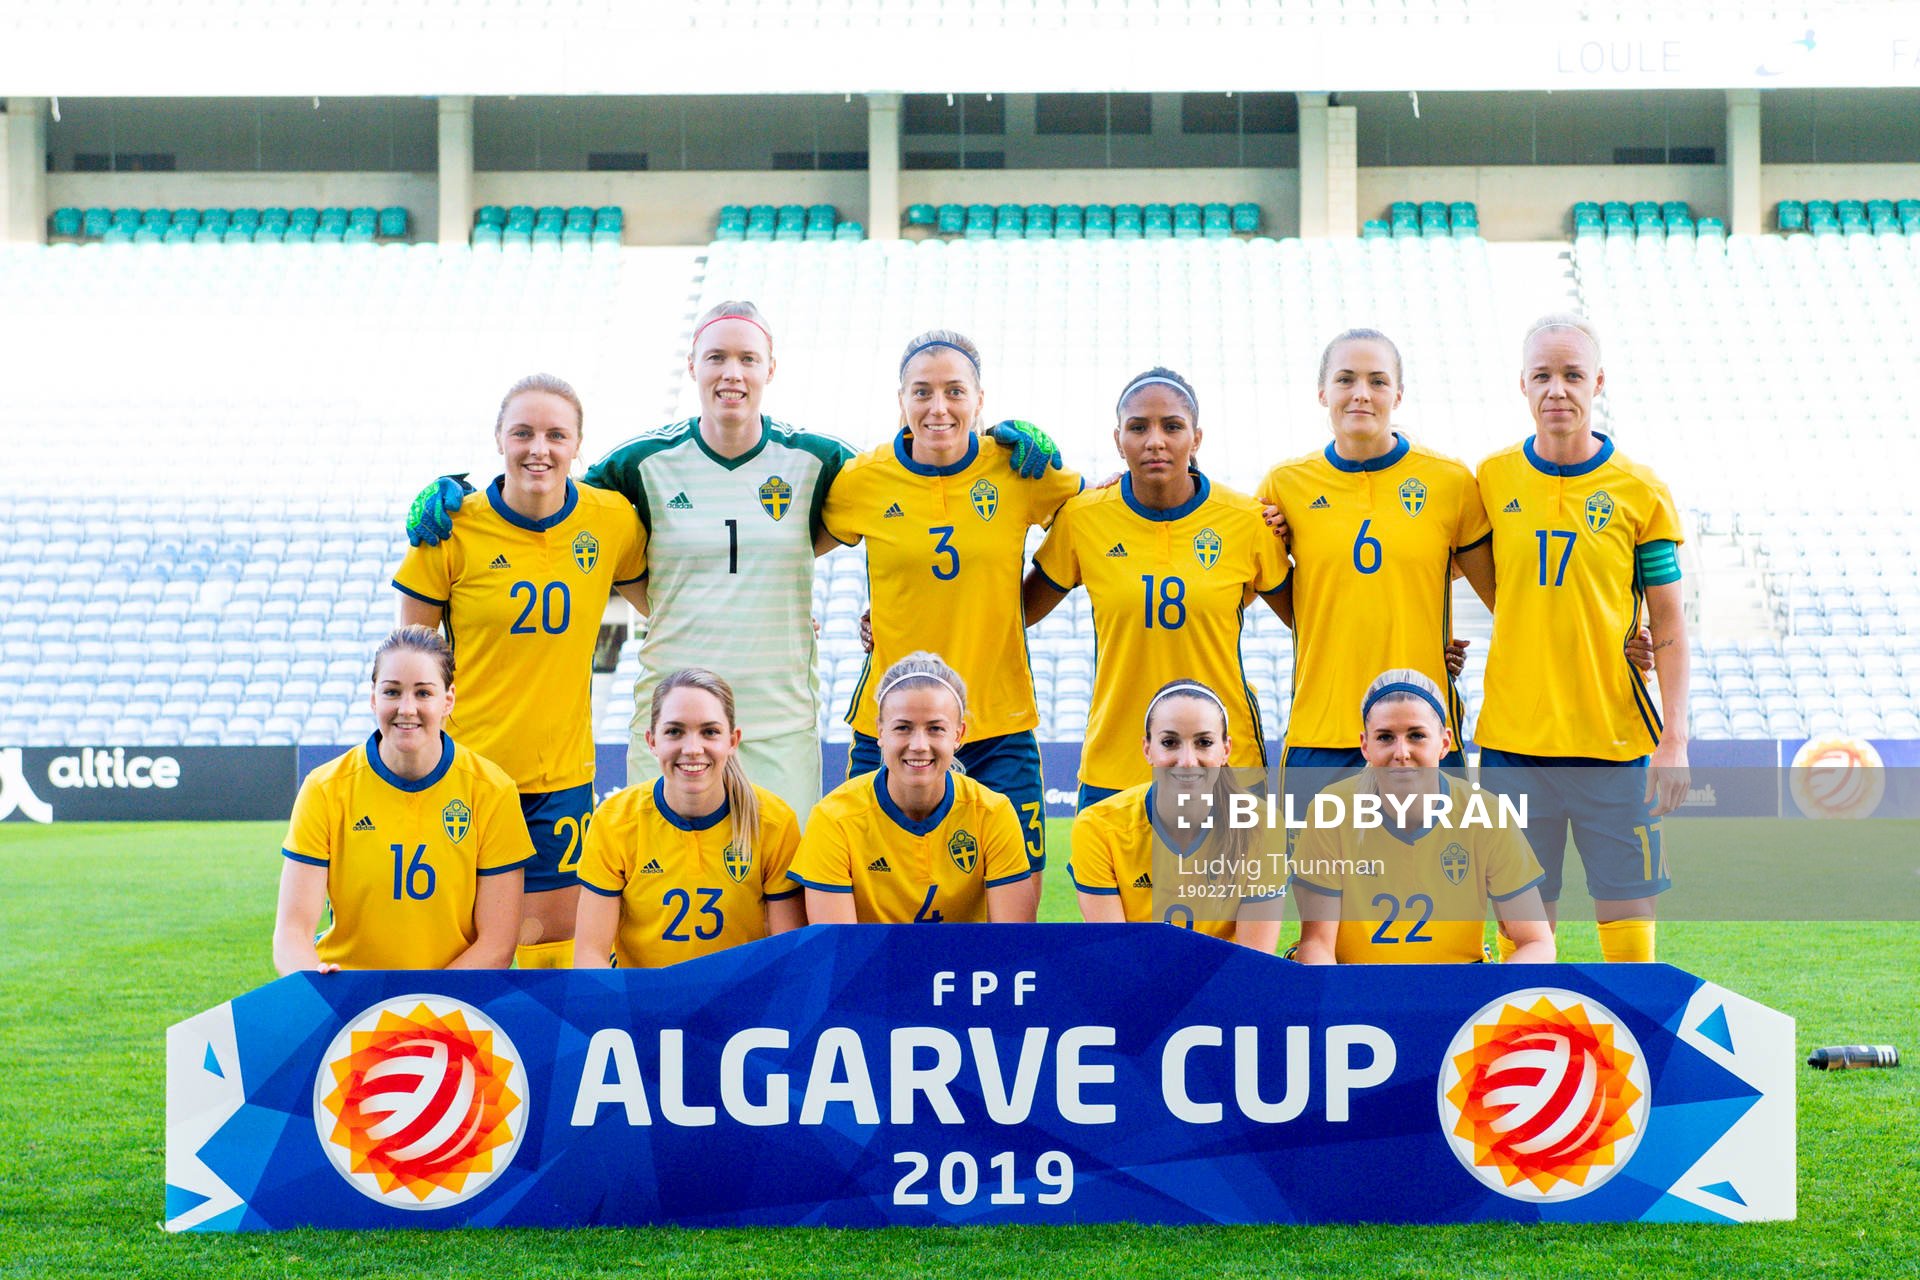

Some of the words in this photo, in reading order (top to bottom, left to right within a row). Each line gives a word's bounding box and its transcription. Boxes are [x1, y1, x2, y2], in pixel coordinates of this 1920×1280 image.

[1556, 40, 1681, 74] LOULE
[724, 519, 738, 574] 1
[928, 526, 960, 580] 3
[1353, 519, 1382, 575] 6
[1535, 529, 1577, 587] 17
[510, 581, 571, 635] 20
[1141, 574, 1186, 630] 18
[48, 747, 181, 788] altice
[1021, 801, 1044, 857] 3
[390, 844, 436, 900] 16
[661, 888, 724, 942] 23
[1371, 893, 1434, 944] 22
[933, 971, 1036, 1006] FPF
[570, 1026, 1117, 1127] ALGARVE
[1161, 1025, 1397, 1124] CUP
[893, 1150, 1074, 1206] 2019
